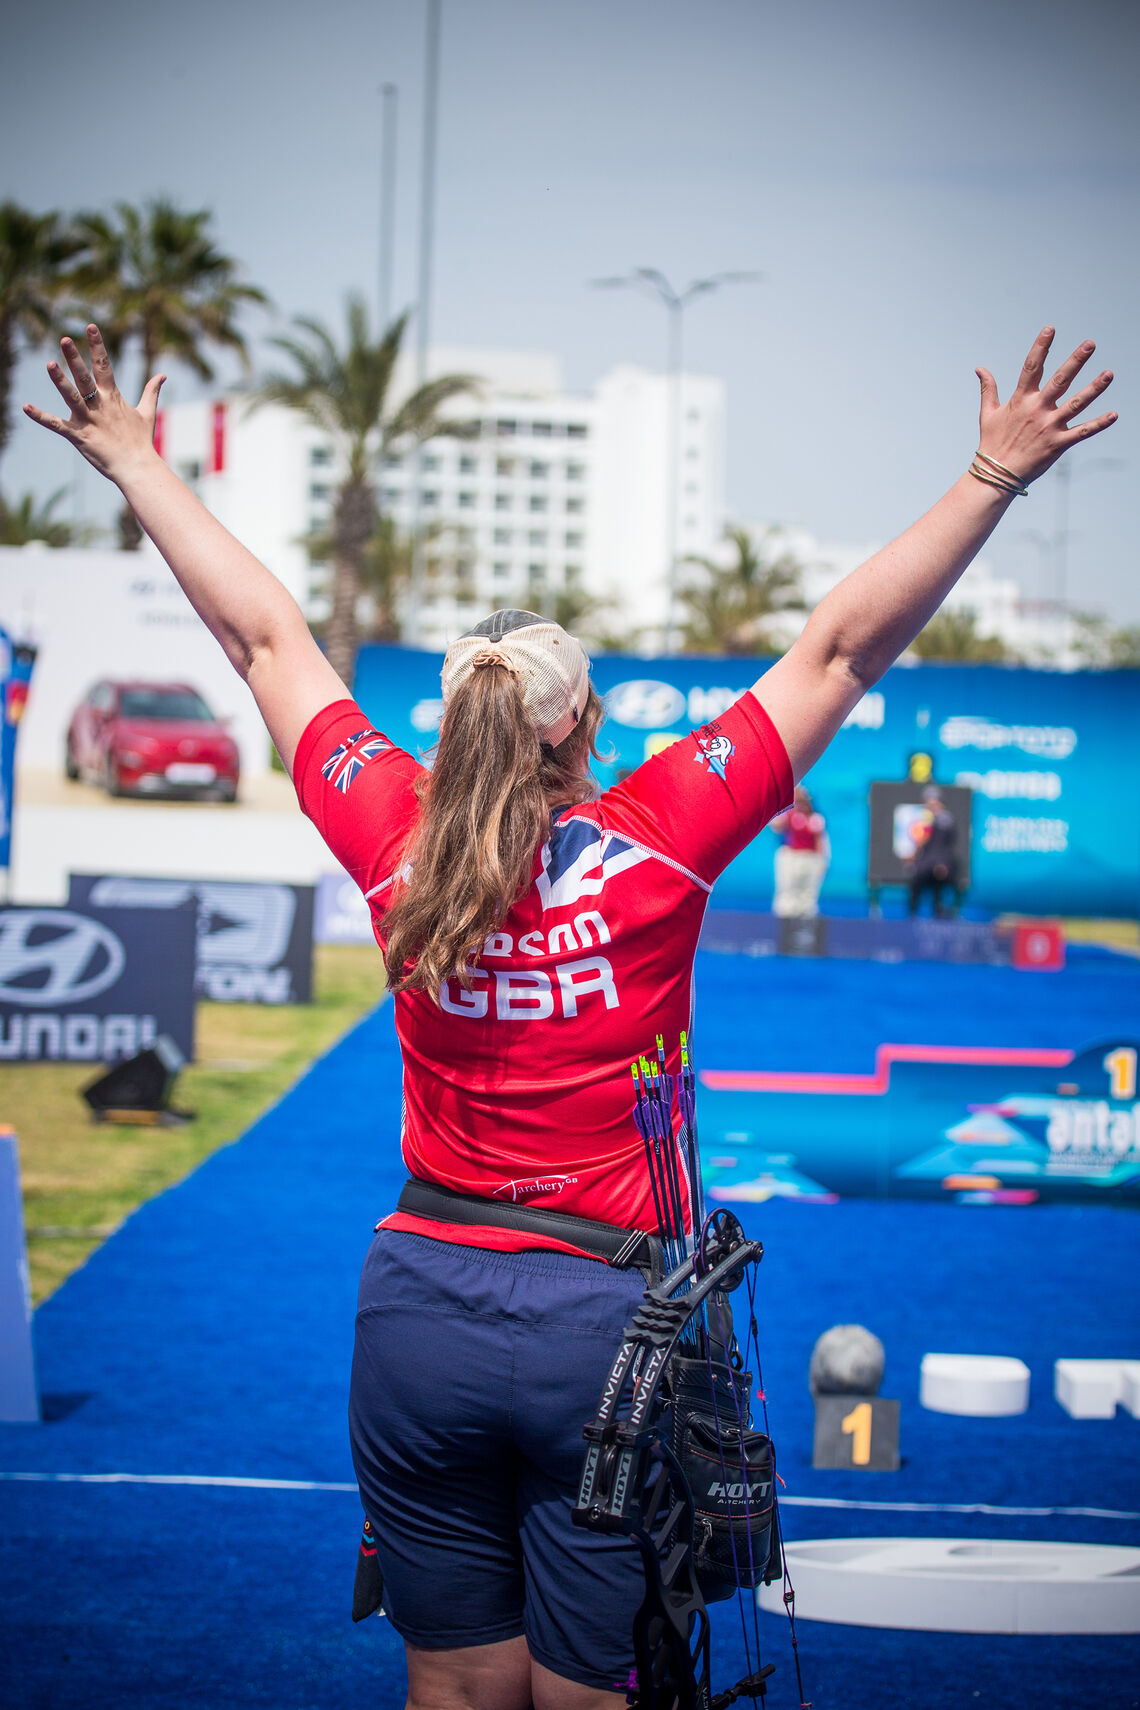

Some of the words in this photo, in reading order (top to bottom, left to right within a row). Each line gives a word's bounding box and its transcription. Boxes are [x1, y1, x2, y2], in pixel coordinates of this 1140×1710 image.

[439, 956, 621, 1021] GBR
[1103, 1047, 1137, 1099] 1
[598, 1342, 634, 1420] INVICTA
[630, 1347, 666, 1425] INVICTA
[841, 1402, 872, 1465] 1
[580, 1448, 598, 1505] HOYT
[613, 1453, 630, 1511] HOYT
[706, 1481, 772, 1498] HOYT
